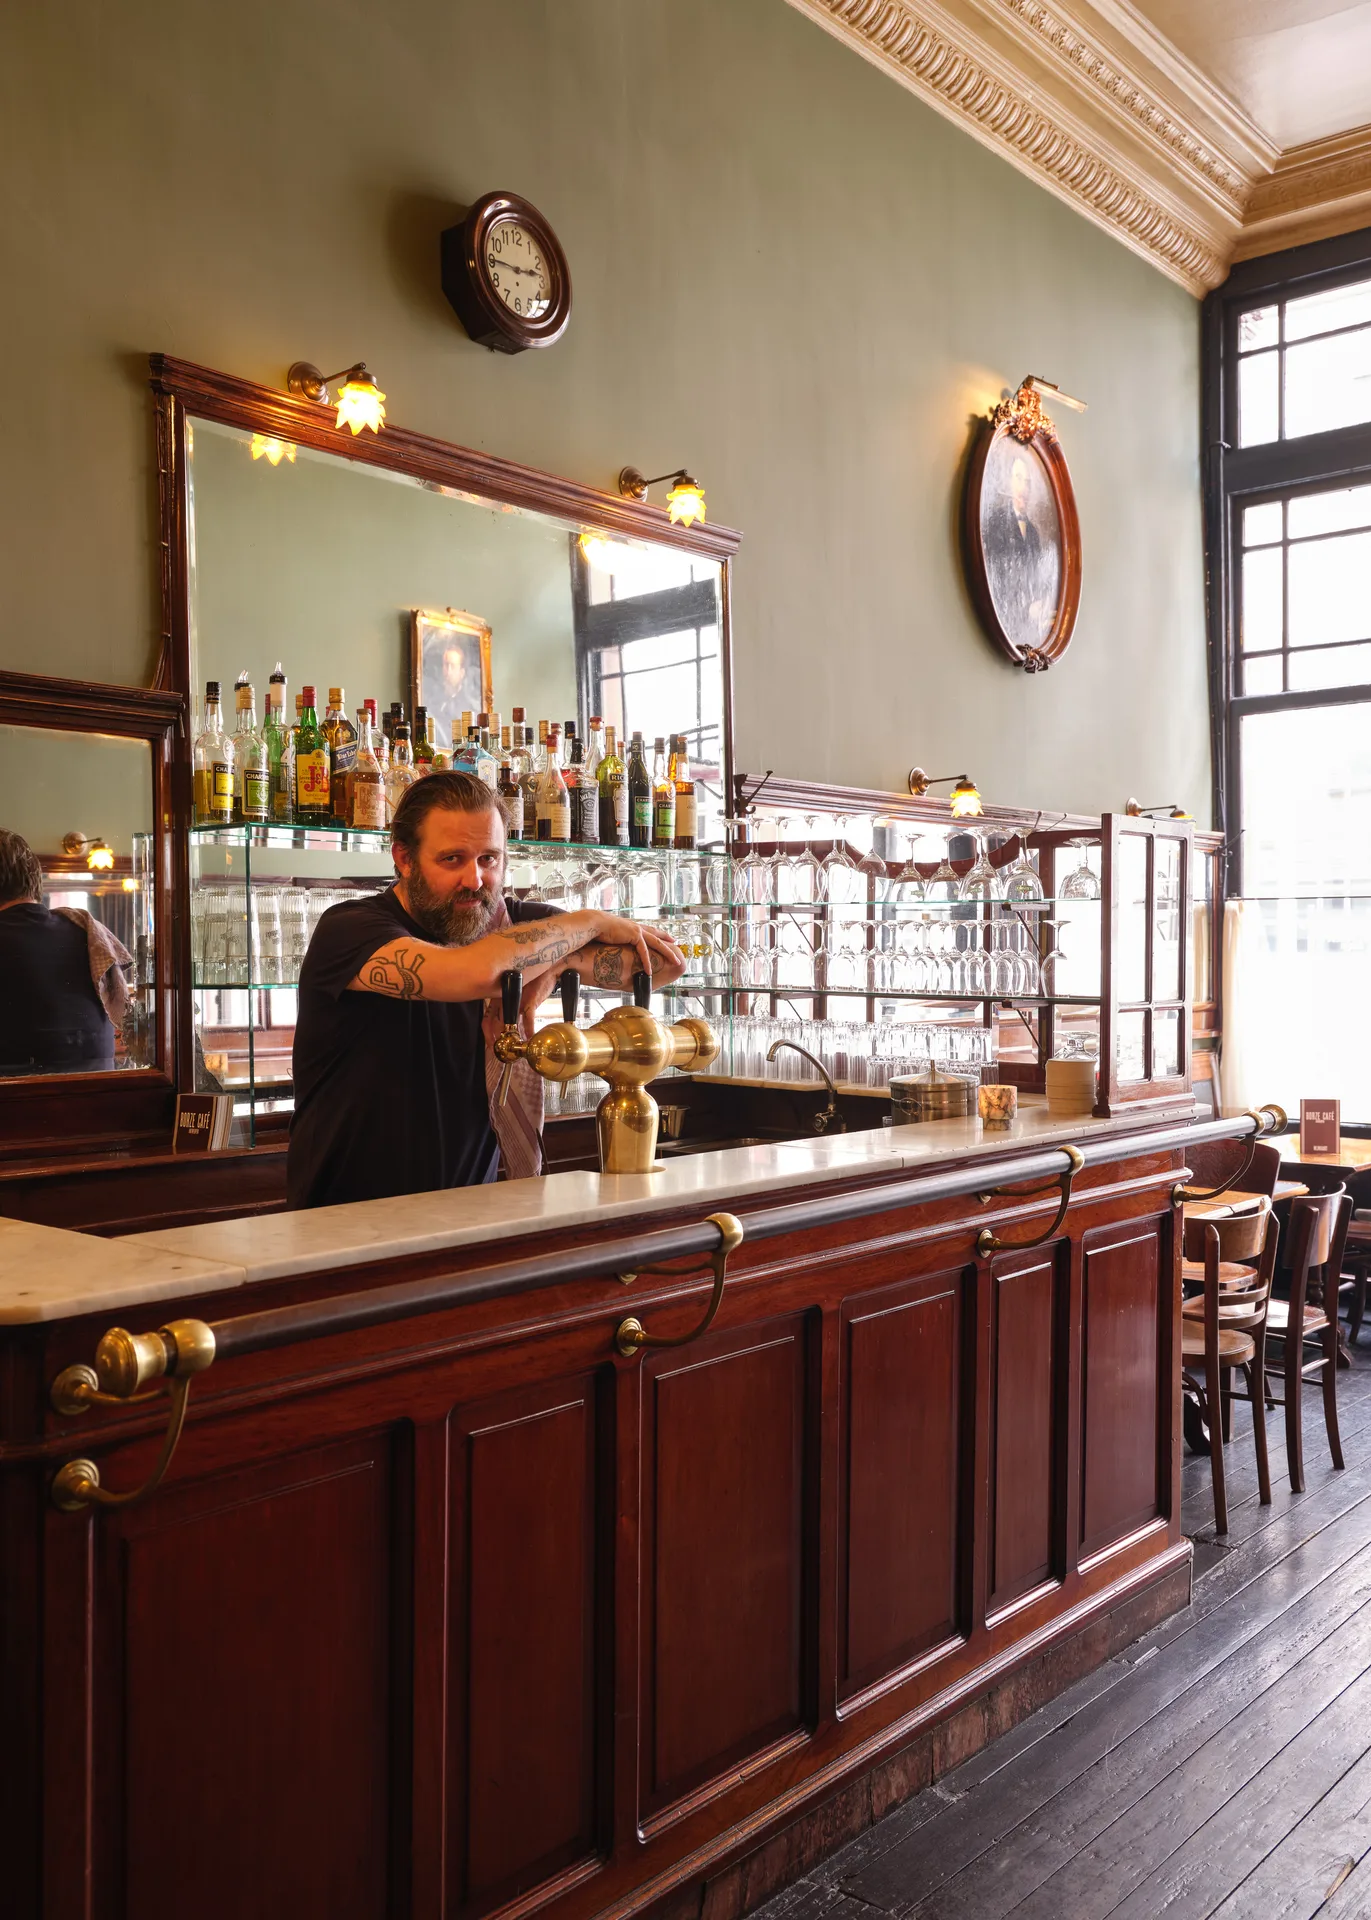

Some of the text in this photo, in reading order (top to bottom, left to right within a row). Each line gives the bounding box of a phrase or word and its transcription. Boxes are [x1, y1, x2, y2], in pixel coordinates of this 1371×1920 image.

[501, 229, 509, 245] 11
[511, 229, 522, 247] 12
[491, 237, 502, 254] 10
[527, 240, 531, 255] 1
[488, 253, 496, 269] 9
[534, 255, 541, 271] 2
[492, 272, 500, 288] 8
[538, 274, 546, 289] 3
[503, 288, 511, 302] 7
[535, 290, 541, 304] 4
[514, 297, 522, 312] 6
[526, 297, 533, 313] 5
[197, 1111, 210, 1128] CAFÉ
[1323, 1111, 1334, 1120] CAFÉ
